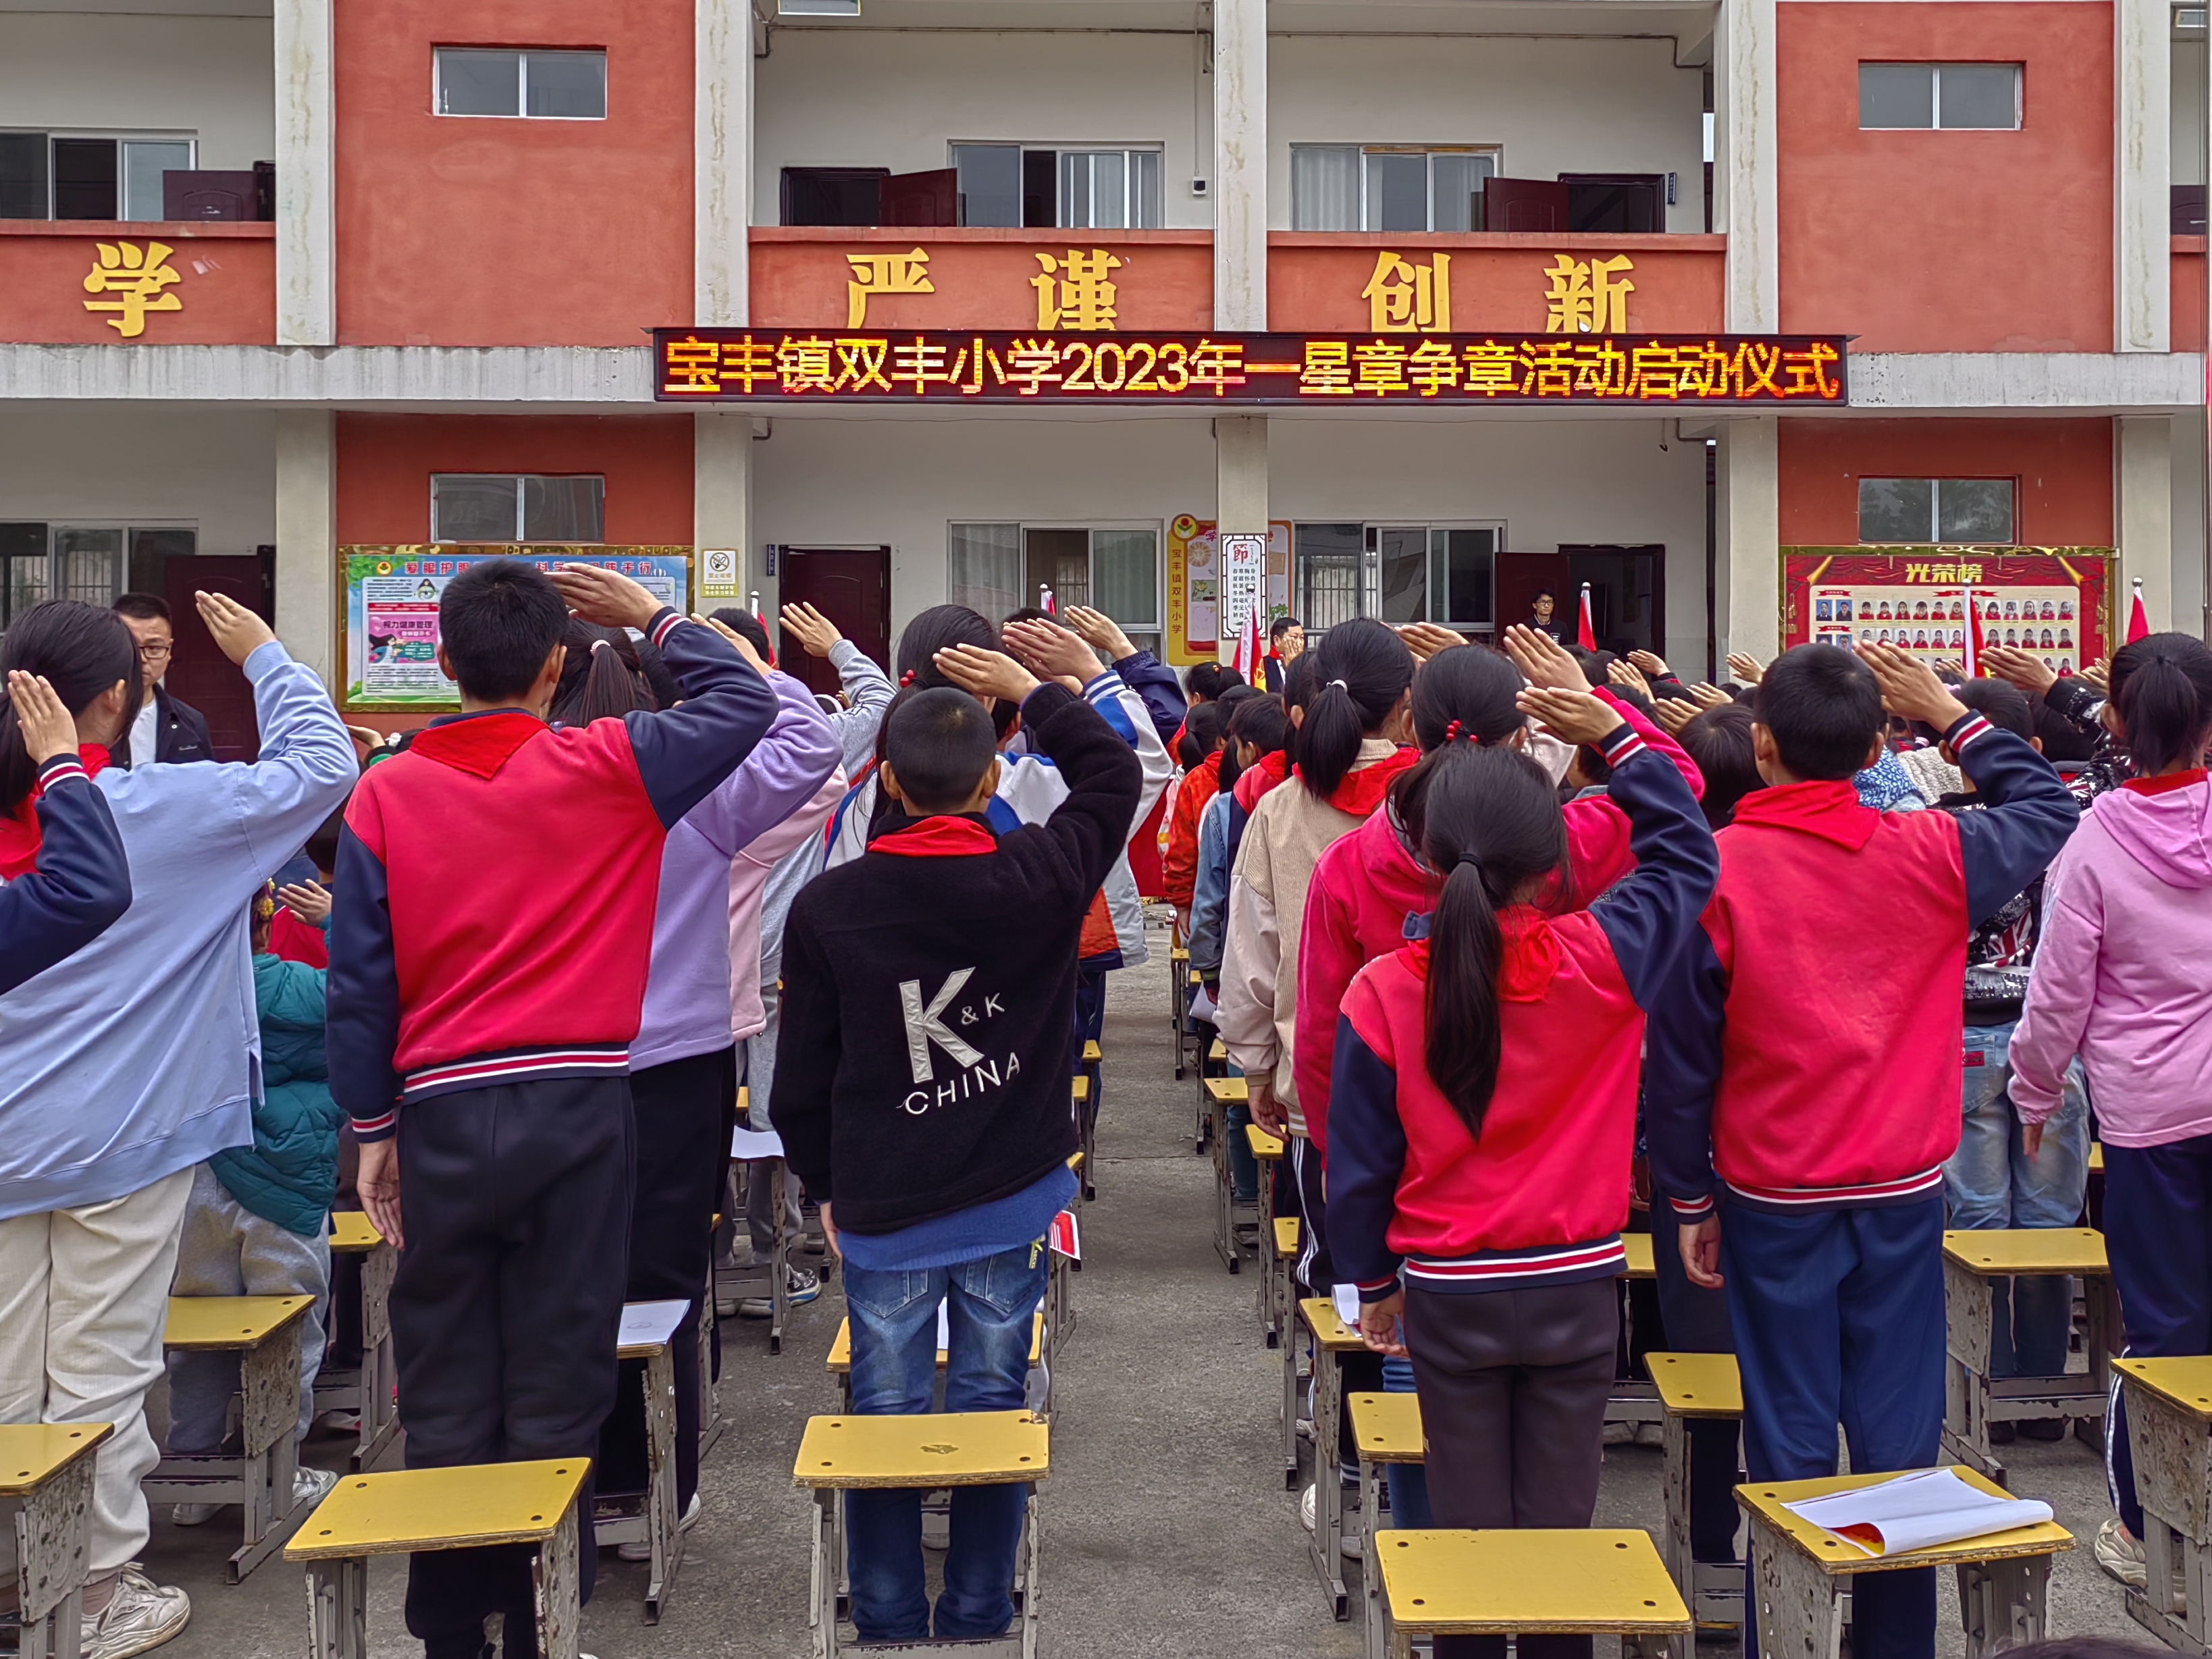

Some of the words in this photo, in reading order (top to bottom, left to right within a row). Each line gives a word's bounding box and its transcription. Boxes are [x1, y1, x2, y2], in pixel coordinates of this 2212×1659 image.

[84, 241, 182, 337] 学
[664, 336, 1839, 399] 宝丰镇双丰小学2023年一星章争章活动启动仪式
[536, 561, 652, 575] 科学眼践于行
[1171, 549, 1182, 634] 宝丰镇双丰小学
[1905, 563, 1982, 583] 光荣榜
[899, 966, 984, 1084] K
[961, 1006, 979, 1025] &
[984, 992, 1005, 1018] K
[905, 1051, 1020, 1114] CHINA
